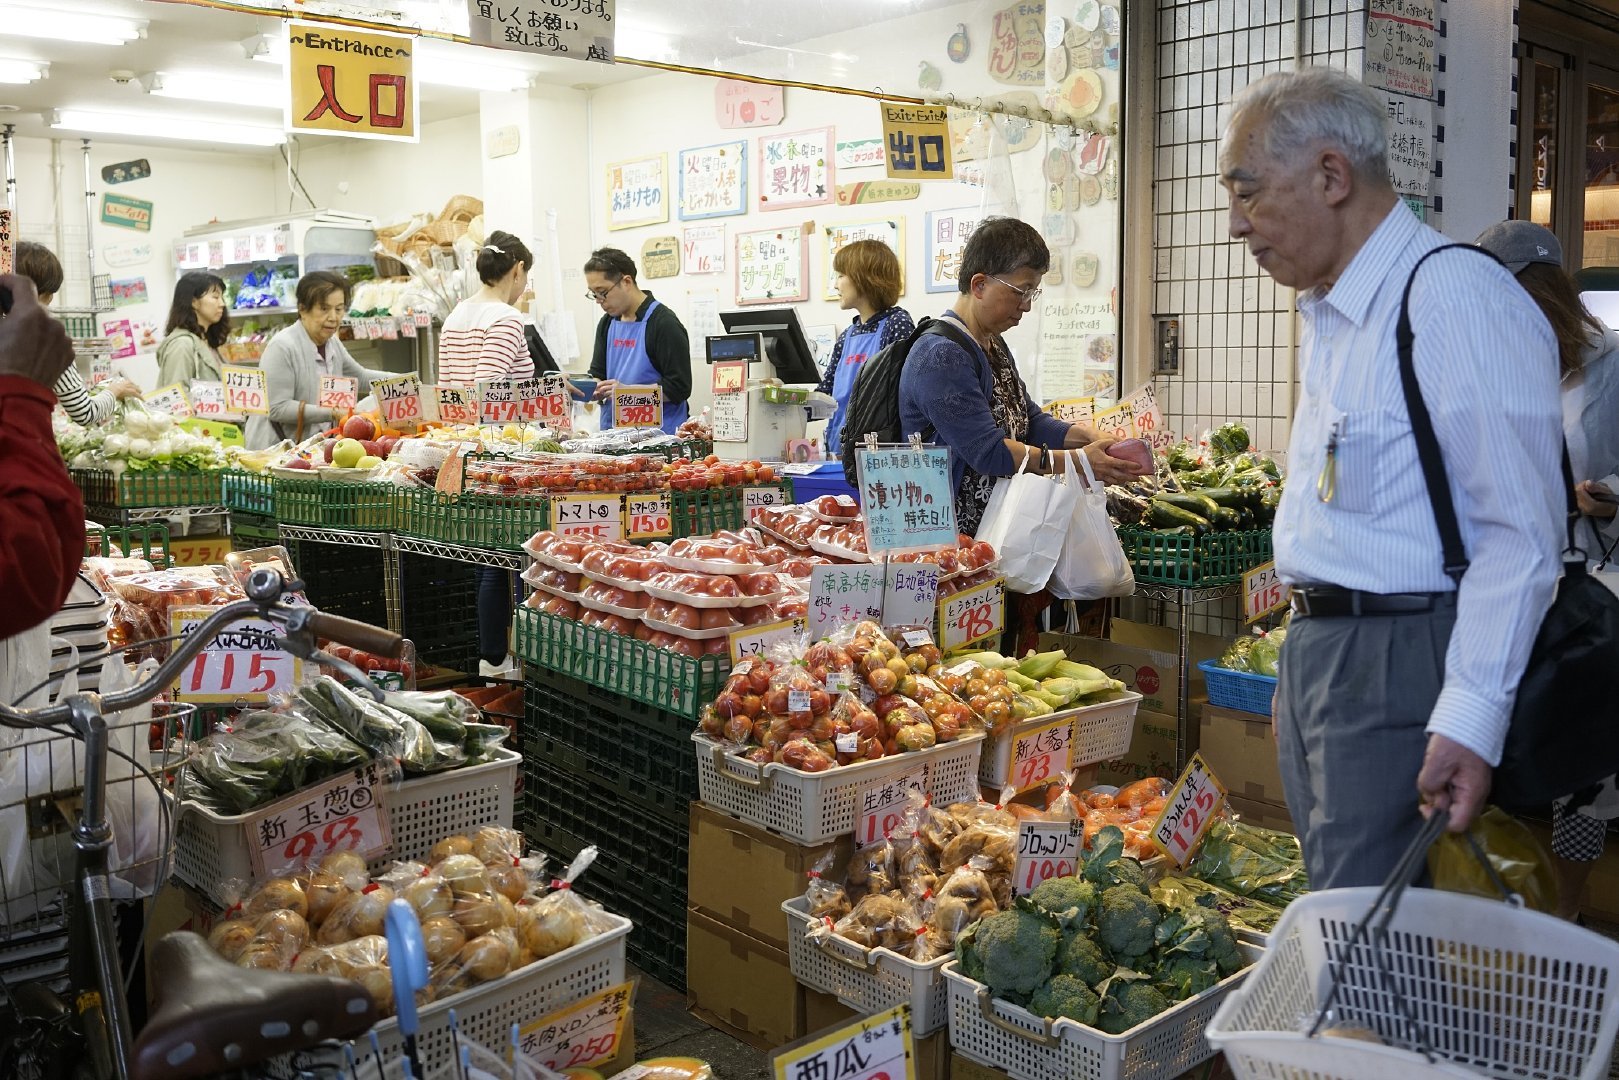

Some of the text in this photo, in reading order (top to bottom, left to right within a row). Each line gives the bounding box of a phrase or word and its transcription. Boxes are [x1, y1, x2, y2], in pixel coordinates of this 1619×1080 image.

[505, 25, 568, 52] 致します。
[303, 64, 406, 128] 入口
[687, 154, 727, 175] 火曜日は
[888, 130, 946, 172] 出口
[771, 163, 811, 196] 果物
[229, 388, 261, 408] 140
[381, 378, 408, 400] りんご
[388, 397, 418, 421] 168
[522, 394, 564, 419] 498
[1137, 411, 1155, 432] 98
[868, 479, 933, 510] 漬け物の
[632, 515, 669, 533] 150
[821, 569, 872, 595] 南高梅
[1250, 568, 1278, 591] レタス
[1254, 584, 1282, 615] 115
[957, 603, 995, 642] 98
[739, 638, 766, 657] トマト
[191, 653, 284, 693] 115
[1020, 754, 1051, 789] 93
[1157, 773, 1199, 846] ほうれん草
[1172, 787, 1214, 852] 125
[1019, 825, 1075, 855] ブロッコリー
[521, 1013, 596, 1054] 赤肉メロン
[796, 1037, 872, 1080] 西瓜
